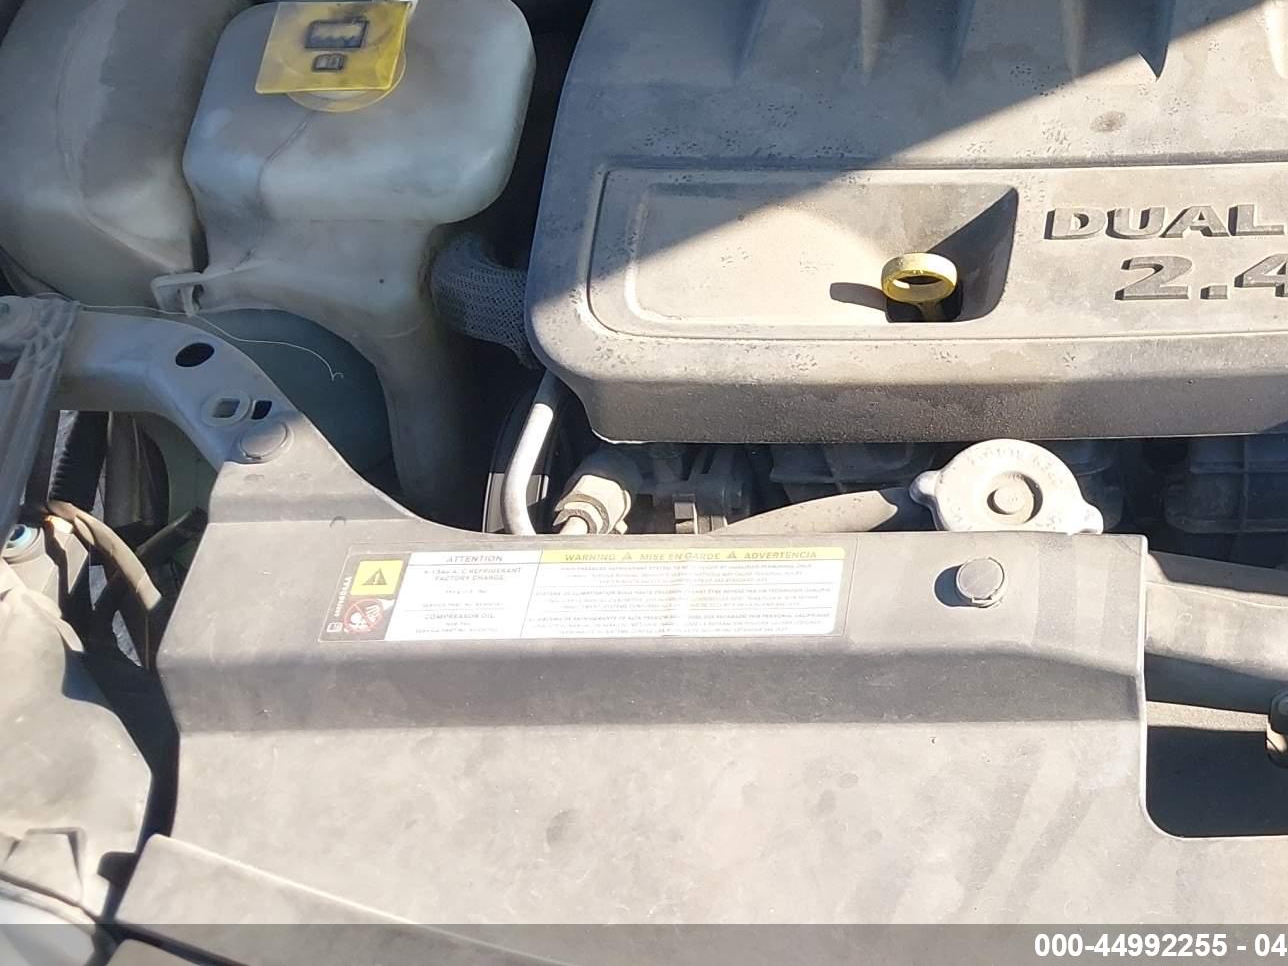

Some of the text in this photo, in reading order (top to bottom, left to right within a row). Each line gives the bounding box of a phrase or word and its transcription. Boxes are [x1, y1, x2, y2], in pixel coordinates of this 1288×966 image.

[1044, 203, 1285, 240] DUAL
[445, 555, 504, 563] ATTENTION
[564, 553, 617, 561] WARNING
[639, 553, 665, 561] MISE
[684, 552, 721, 560] GARDE
[743, 551, 817, 559] ADVERTENCIA
